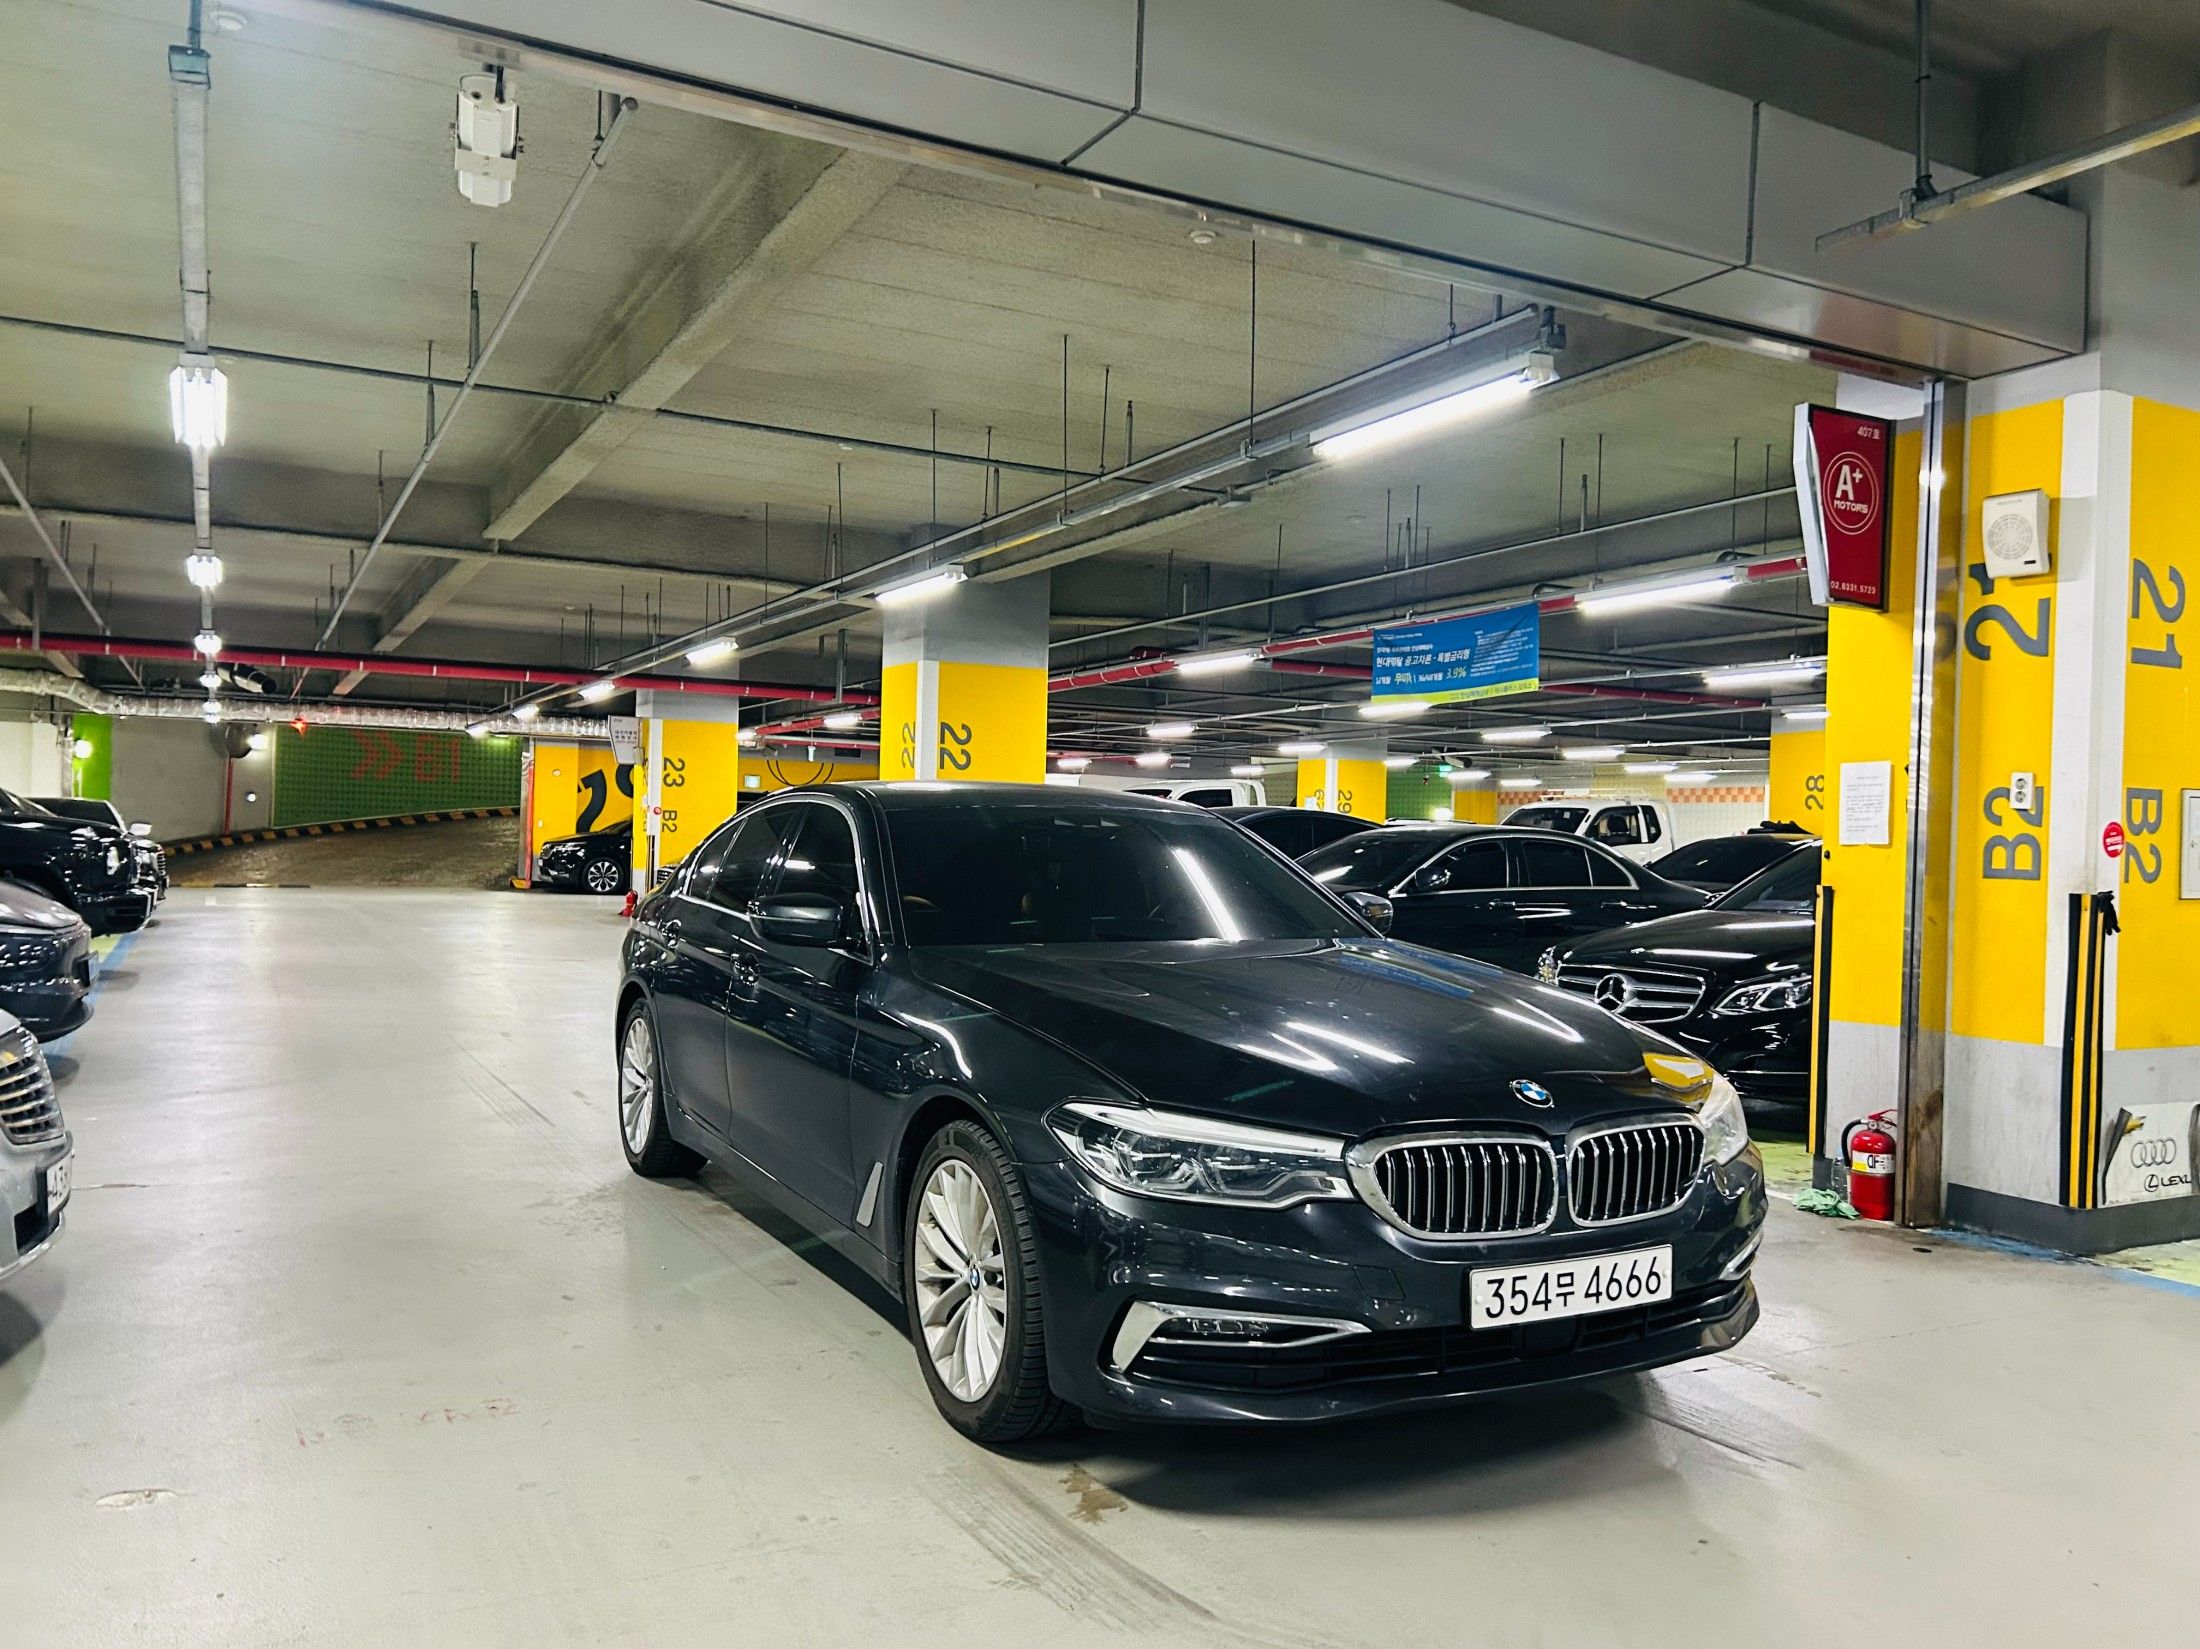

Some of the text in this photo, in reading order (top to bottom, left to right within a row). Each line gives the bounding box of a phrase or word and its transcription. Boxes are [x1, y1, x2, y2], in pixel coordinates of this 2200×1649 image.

[1835, 464, 1863, 501] A+
[1833, 499, 1869, 514] MOTORS
[2131, 557, 2186, 669] 21
[1445, 665, 1467, 680] 3.9%
[939, 721, 972, 771] 22
[662, 756, 685, 788] 23
[1338, 789, 1353, 814] 29
[661, 809, 678, 833] B2
[1982, 786, 2044, 881] B2
[2124, 787, 2163, 884] B2
[1485, 1256, 1661, 1319] 354무 4666
